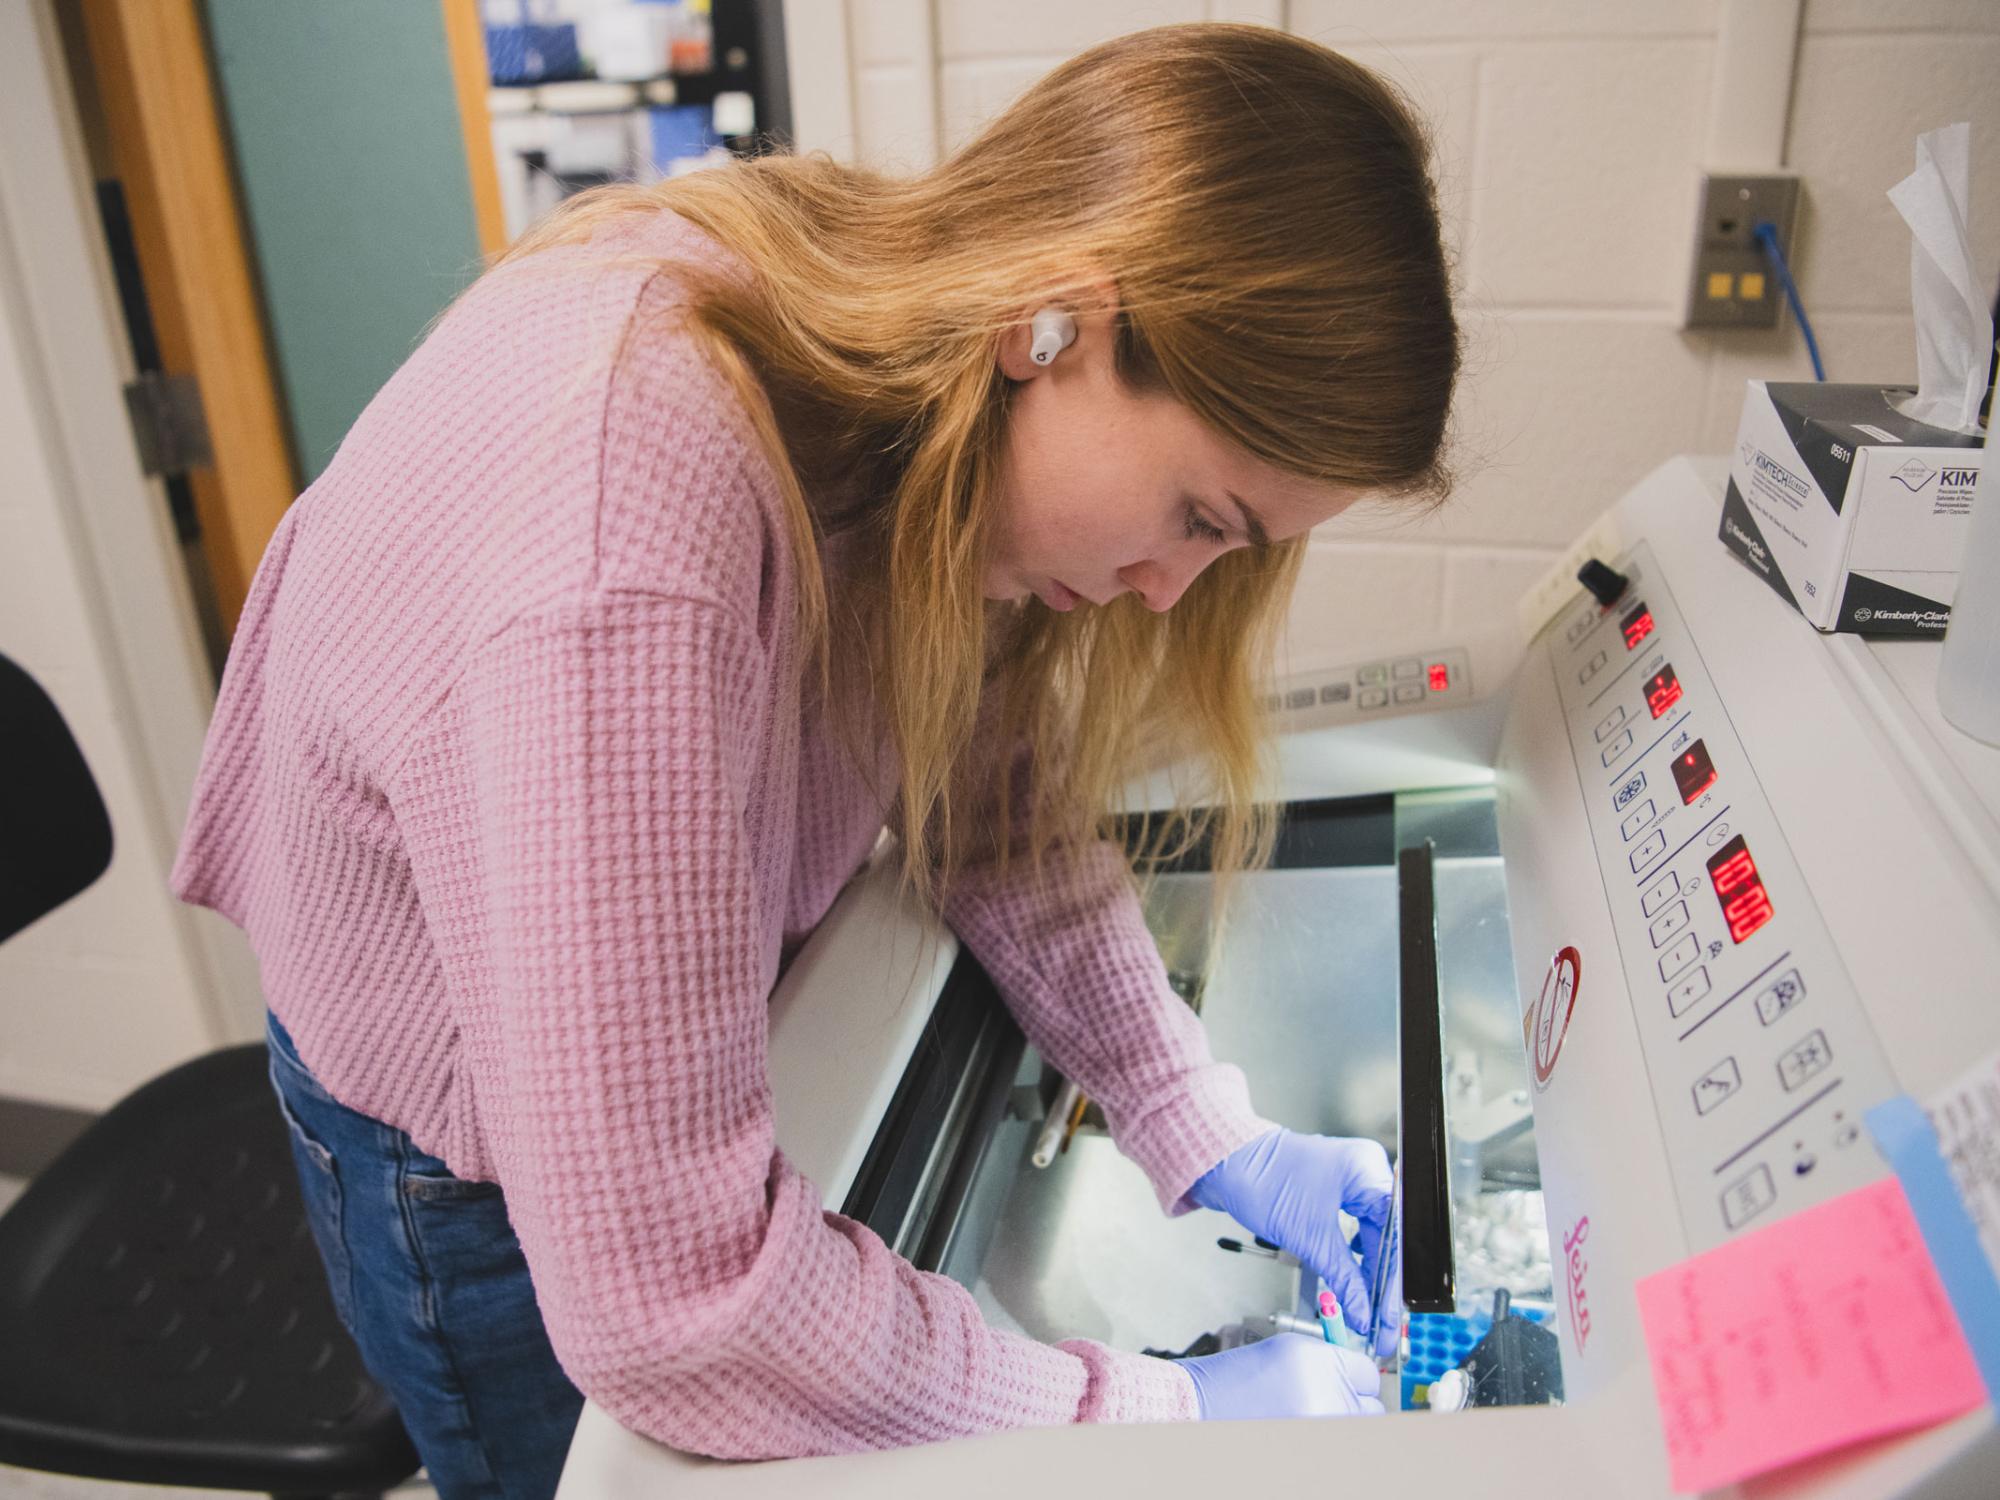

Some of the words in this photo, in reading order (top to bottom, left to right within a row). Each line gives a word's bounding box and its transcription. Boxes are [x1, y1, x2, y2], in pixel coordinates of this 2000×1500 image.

[1755, 453, 1789, 488] KIMTECH
[1940, 471, 1978, 486] KIM
[1917, 621, 1947, 629] Profess
